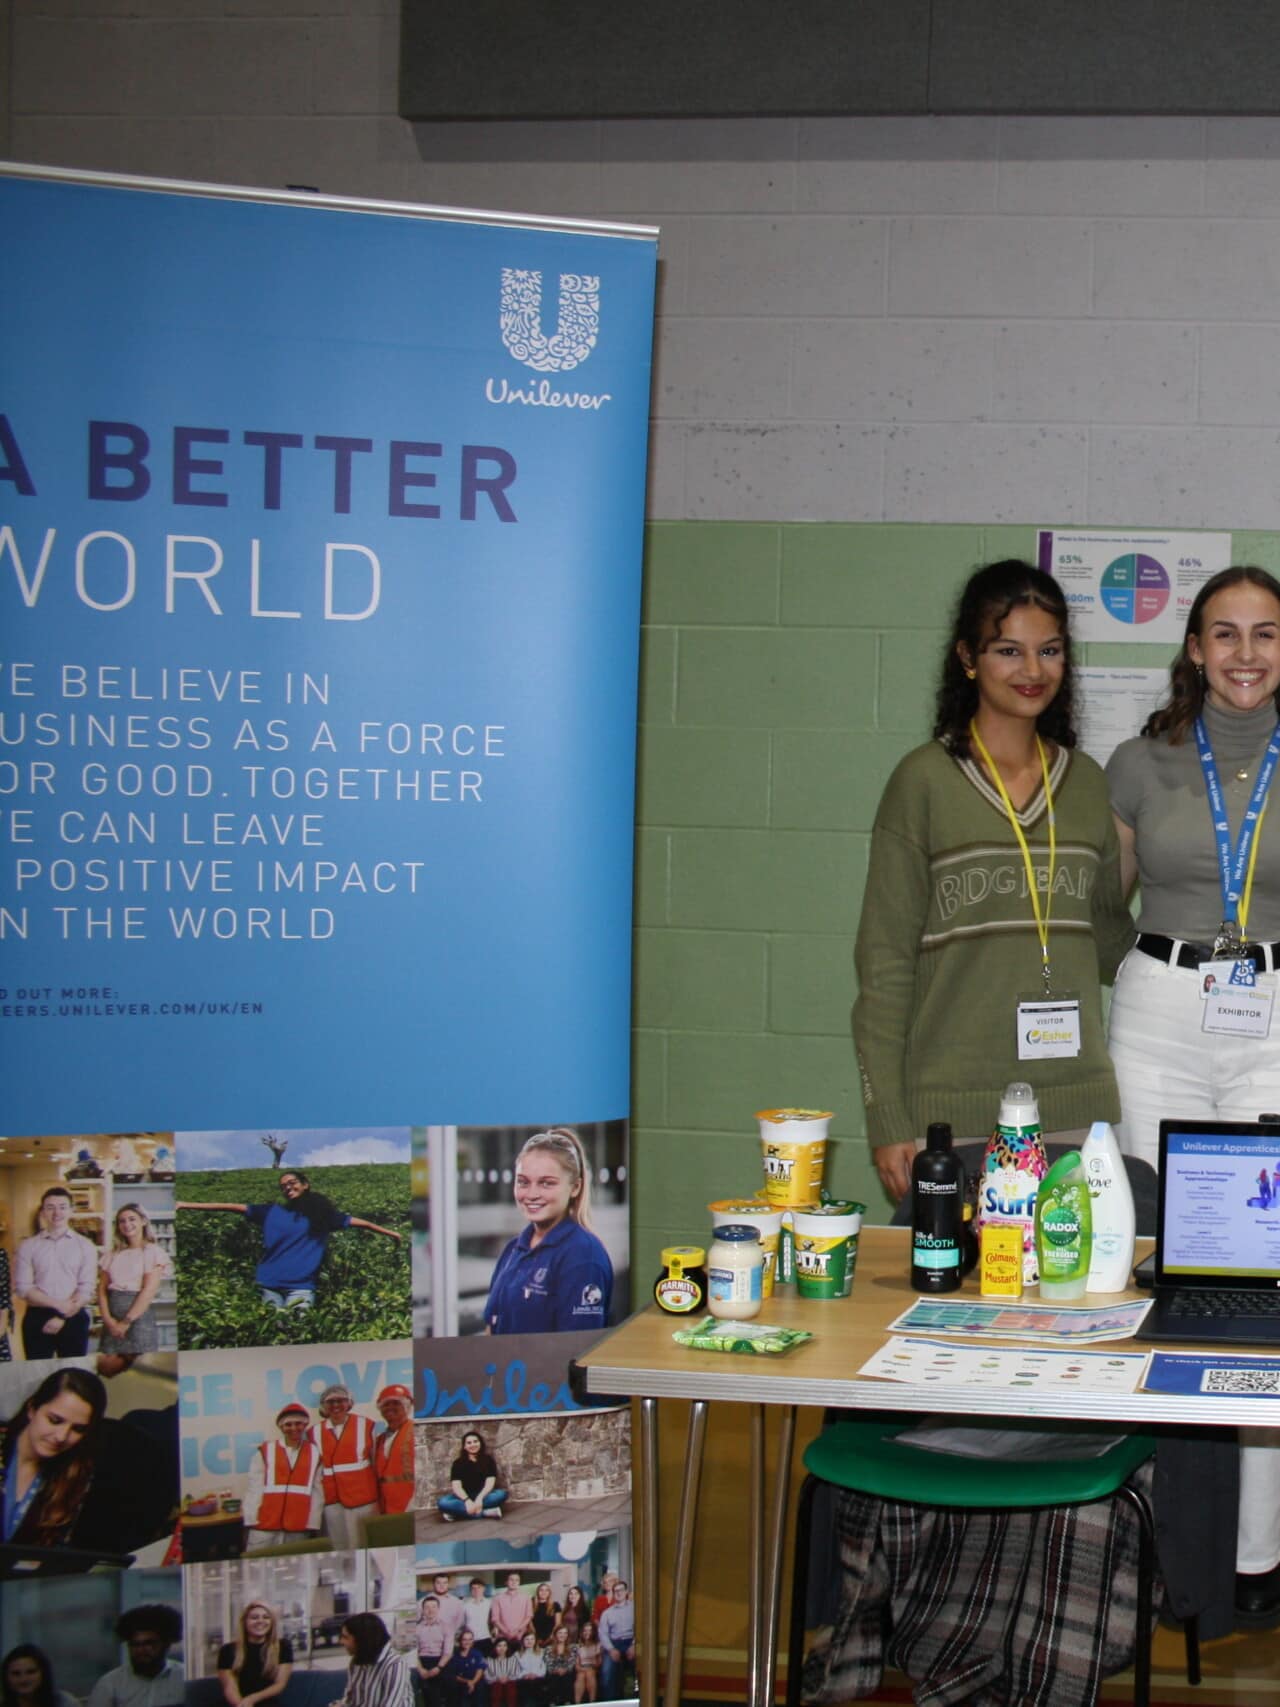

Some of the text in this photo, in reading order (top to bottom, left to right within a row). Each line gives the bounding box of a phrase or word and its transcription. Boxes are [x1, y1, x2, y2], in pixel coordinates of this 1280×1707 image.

[485, 378, 611, 410] Unilever
[87, 420, 518, 523] BETTER
[0, 526, 381, 622] WORLD
[62, 665, 262, 703] BELIEVE
[287, 672, 330, 705] IN
[233, 719, 289, 752] AS
[311, 721, 338, 753] A
[360, 722, 506, 757] FORCE
[82, 762, 229, 798] GOOD.
[242, 766, 484, 802] TOGETHER
[59, 811, 157, 844] CAN
[183, 813, 325, 846] LEAVE
[17, 859, 425, 893] POSITIVE IMPACT
[936, 866, 1017, 921] BDG
[54, 907, 147, 939] THE
[169, 907, 335, 940] WORLD
[17, 988, 52, 1000] OUT
[62, 987, 120, 1000] MORE:
[1217, 1007, 1262, 1018] EXHIBITOR
[1182, 1141, 1221, 1152] Unilever
[985, 1187, 1038, 1216] Surf
[1043, 1222, 1079, 1232] RADOX
[915, 1239, 954, 1248] SMOOTH
[985, 1252, 1018, 1265] Colman's
[661, 1280, 696, 1292] MARMITE
[985, 1272, 1018, 1284] Mustard
